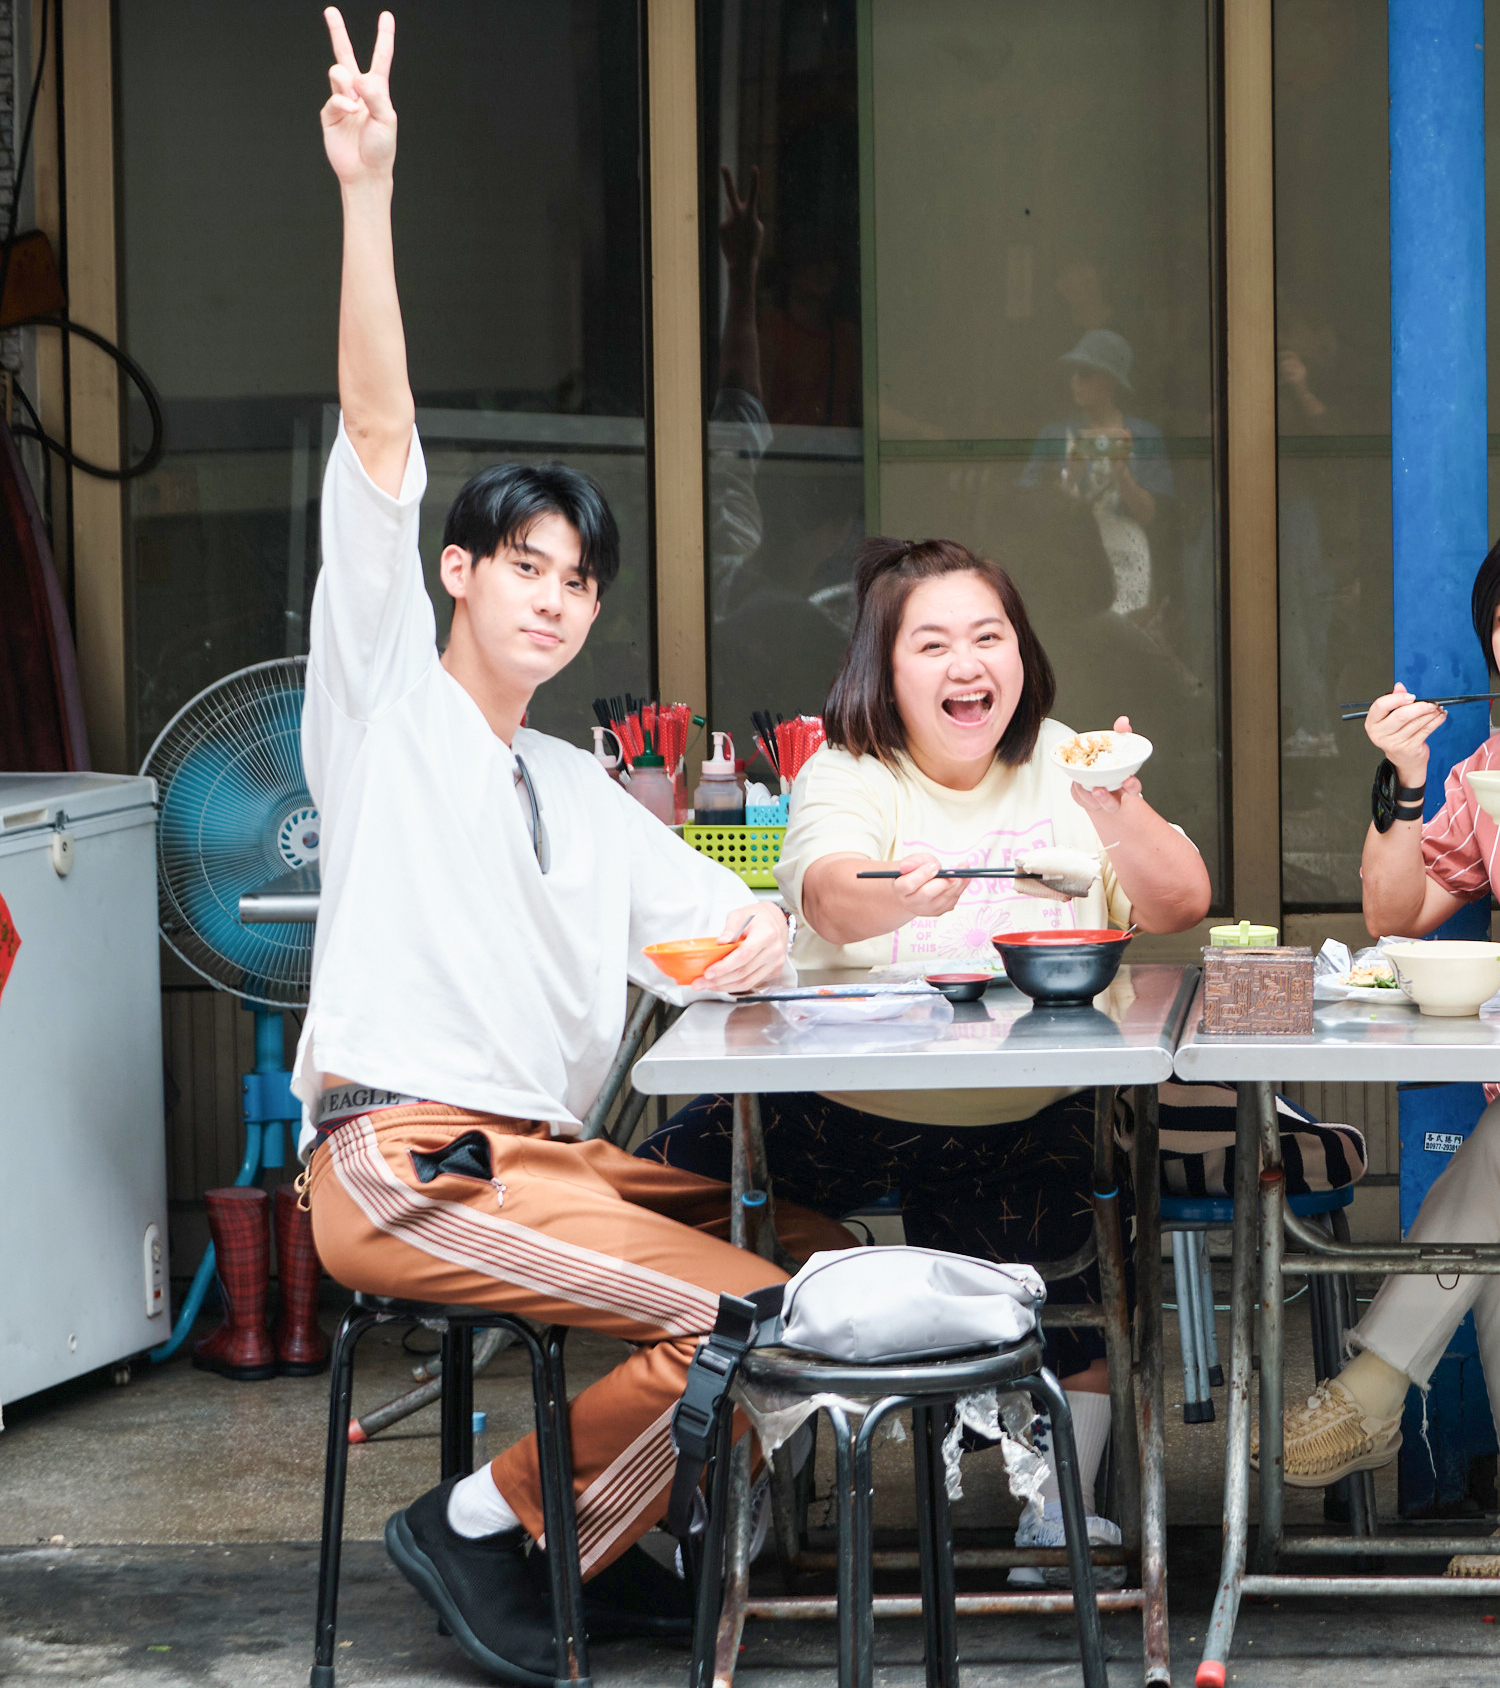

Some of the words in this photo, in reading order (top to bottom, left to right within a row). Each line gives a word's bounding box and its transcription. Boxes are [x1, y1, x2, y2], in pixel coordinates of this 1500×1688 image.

[910, 919, 937, 929] PART
[916, 931, 931, 941] OF
[911, 943, 937, 953] THIS
[328, 1088, 400, 1113] EAGLE
